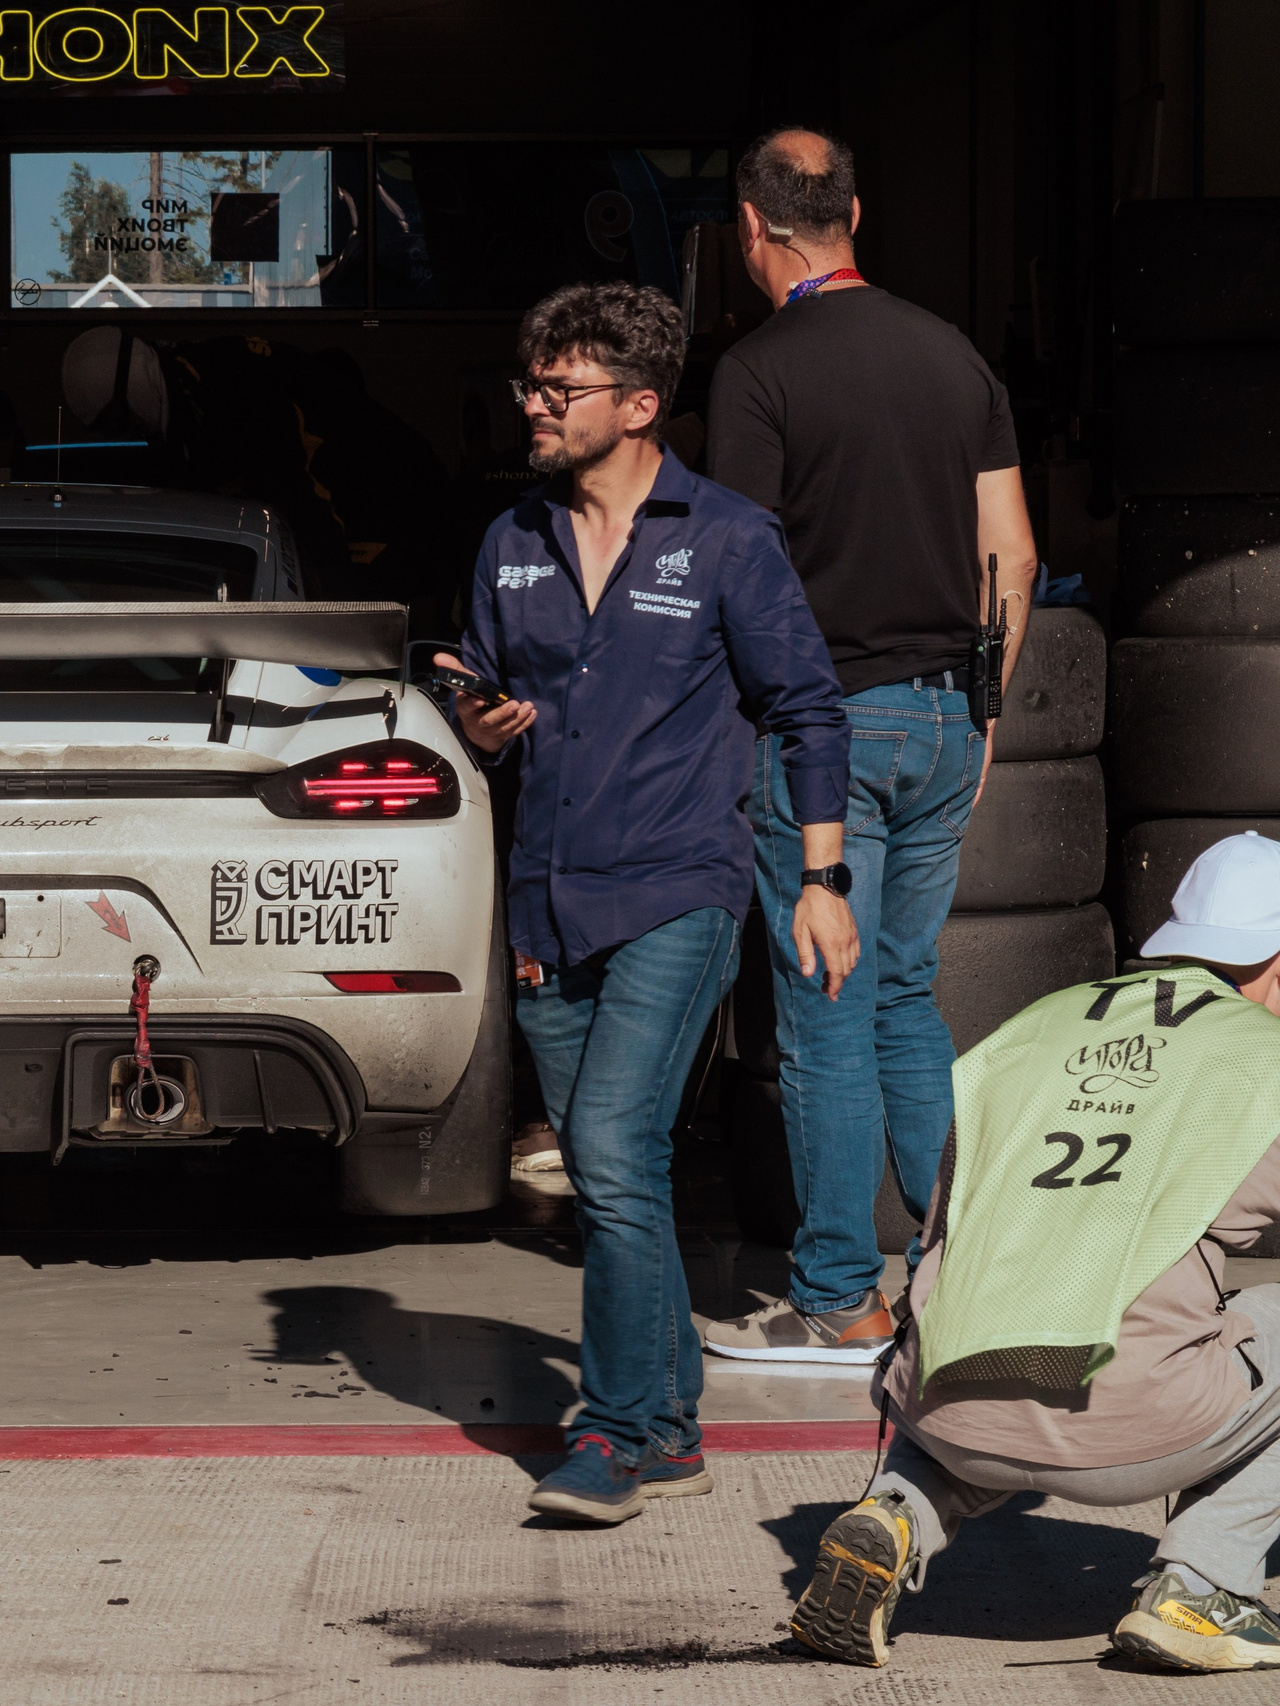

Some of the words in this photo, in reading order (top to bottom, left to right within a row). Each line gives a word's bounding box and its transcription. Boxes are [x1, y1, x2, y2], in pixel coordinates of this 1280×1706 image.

[655, 577, 683, 587] ДРАЙВ
[629, 590, 701, 609] ТЕХНИЧЕСКАЯ
[633, 602, 692, 619] КОМИССИЯ
[256, 859, 399, 900] СМАРТ
[256, 903, 399, 945] ПРИНТ
[1083, 977, 1224, 1028] TV
[1066, 1099, 1135, 1116] ДРАЙВ
[1030, 1131, 1132, 1190] 22
